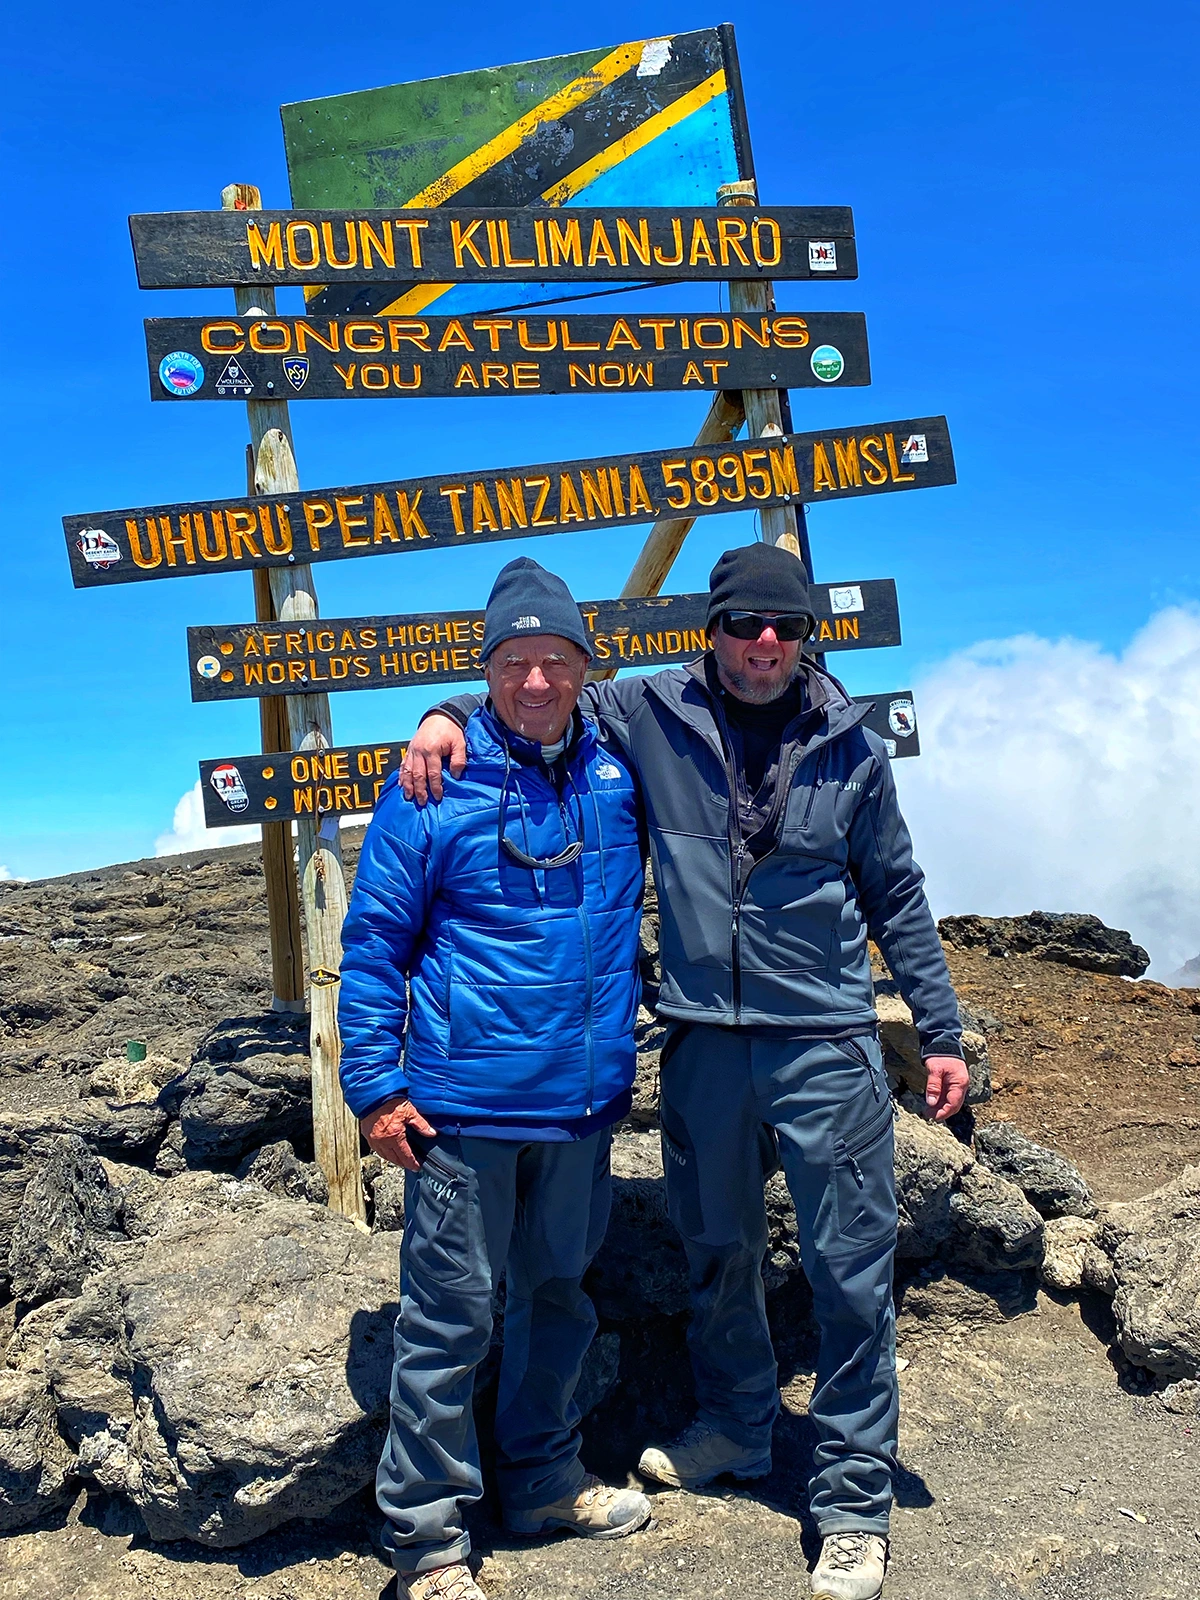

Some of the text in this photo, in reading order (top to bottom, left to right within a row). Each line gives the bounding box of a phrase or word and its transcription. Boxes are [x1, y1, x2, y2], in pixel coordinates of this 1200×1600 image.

[246, 216, 782, 271] MOUNT KILIMANJARO
[201, 317, 811, 354] CONGRATULATIONS
[165, 352, 202, 369] HEALTH FOR
[333, 360, 729, 390] YOU ARE NOW AT
[173, 383, 198, 395] FUTURE
[125, 432, 916, 569] UHURU PEAK TANZANIA, 5895M AMSL
[386, 620, 485, 647] HIGHES
[243, 629, 715, 686] WORLD'S HIGHES STANDIN
[290, 751, 350, 783] ONE
[357, 747, 391, 777] OF
